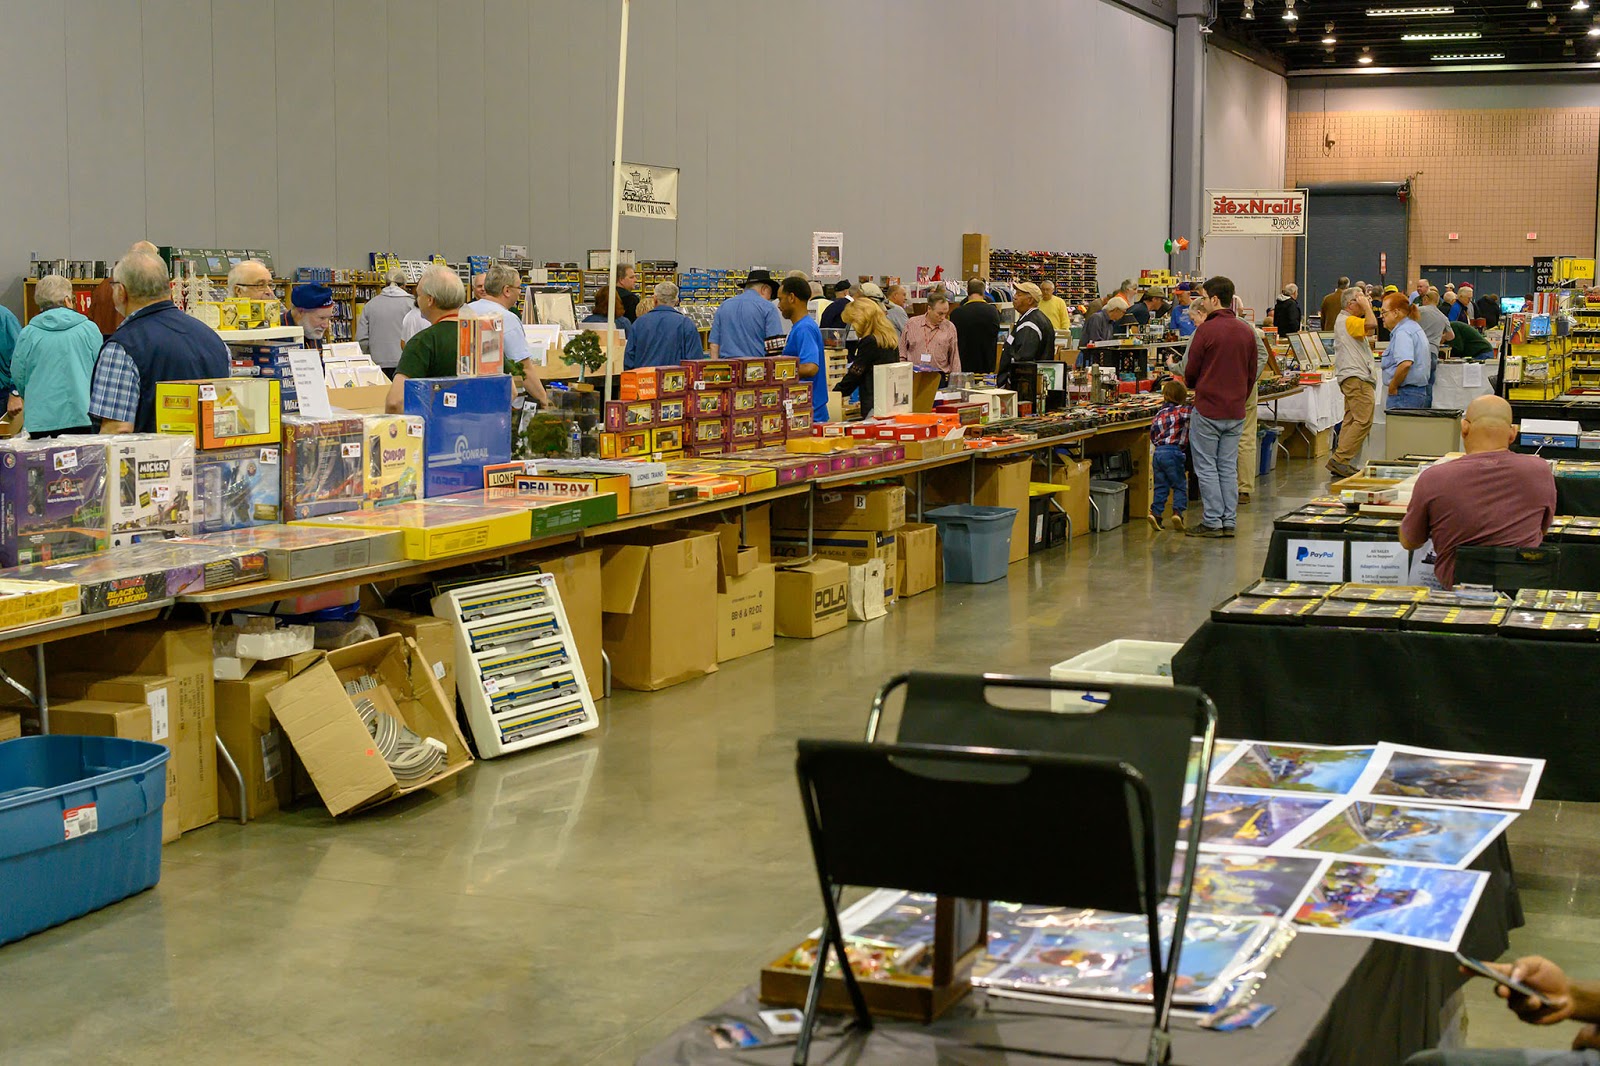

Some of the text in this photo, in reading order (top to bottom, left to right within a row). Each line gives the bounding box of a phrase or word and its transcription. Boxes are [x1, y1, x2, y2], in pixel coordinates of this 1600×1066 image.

[626, 203, 646, 213] BRAD'S
[648, 205, 667, 215] TRAINS
[1213, 195, 1302, 214] TexNrails
[462, 448, 489, 461] CONRAIL
[140, 461, 169, 473] MICKEY
[493, 472, 514, 484] LIONE
[856, 496, 864, 507] B
[106, 587, 135, 600] BLACK
[108, 592, 148, 607] DIAMOND
[815, 584, 846, 612] POLA
